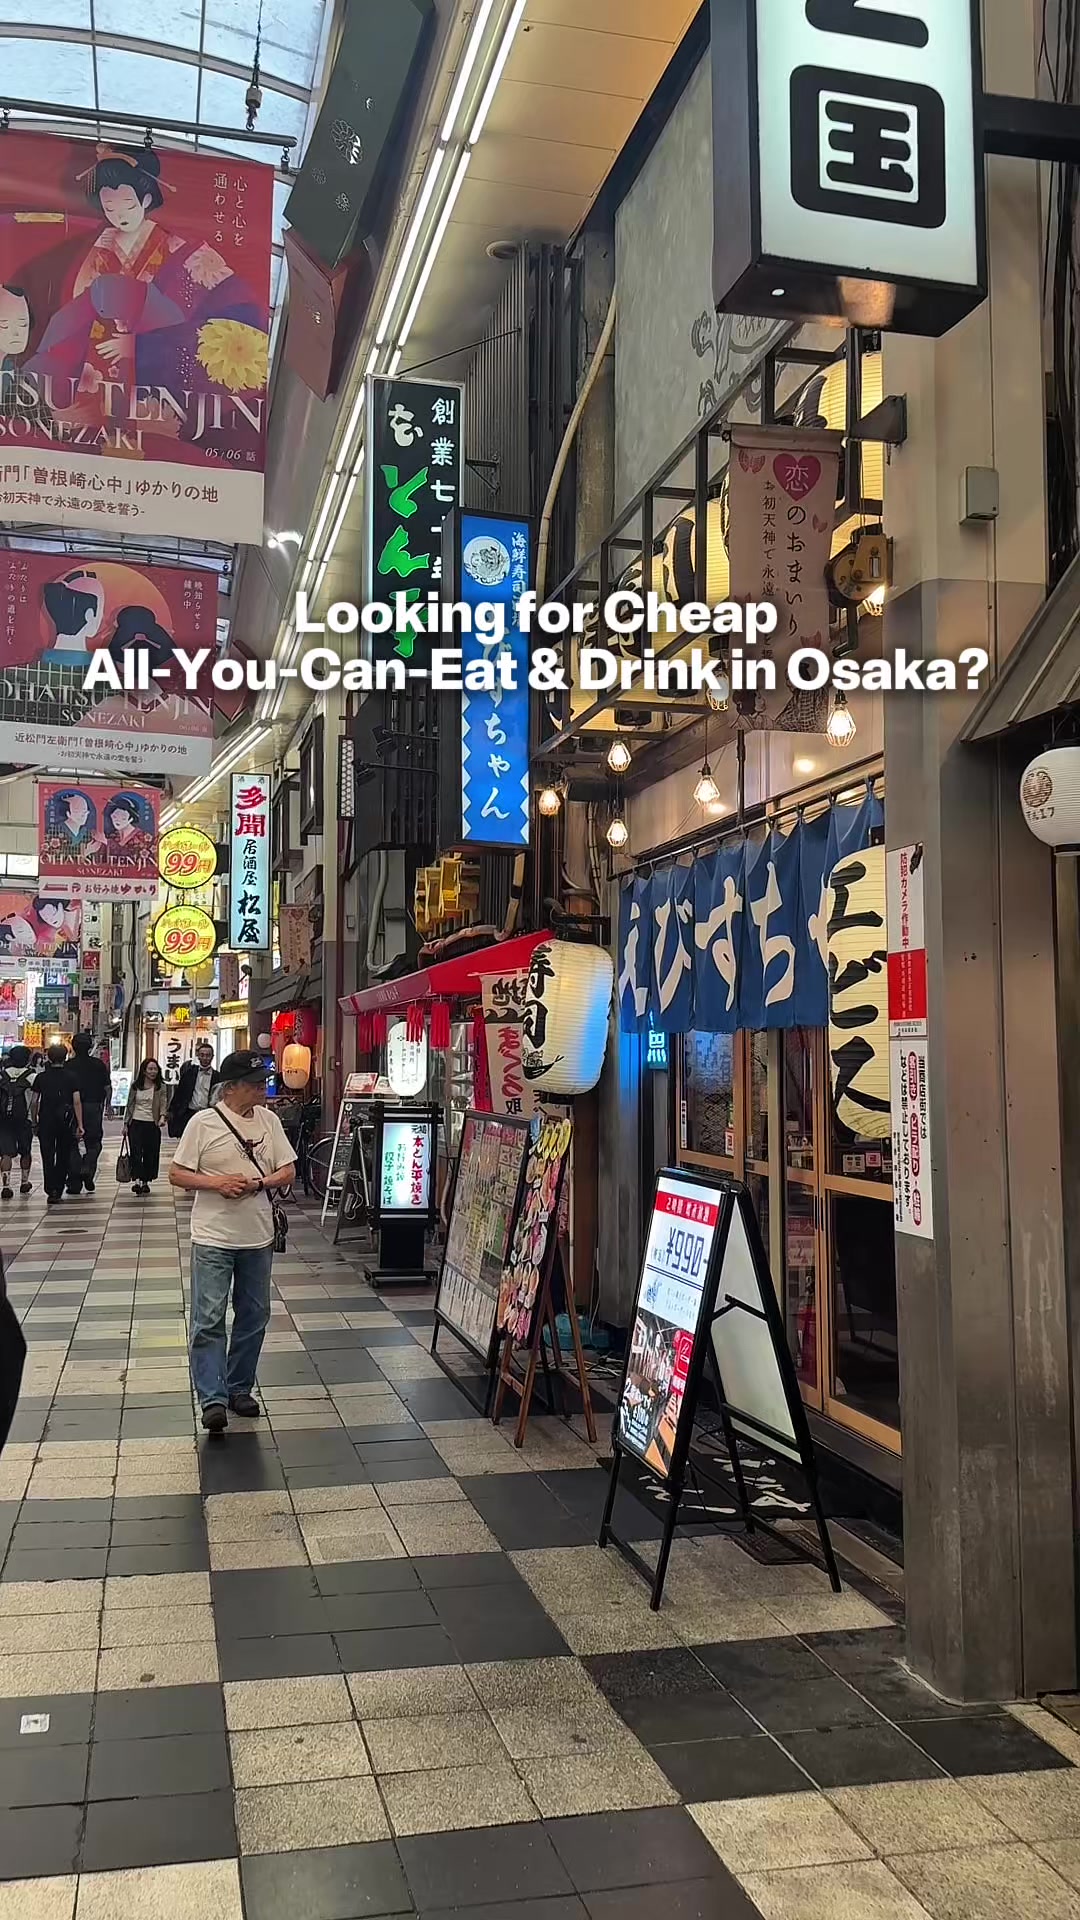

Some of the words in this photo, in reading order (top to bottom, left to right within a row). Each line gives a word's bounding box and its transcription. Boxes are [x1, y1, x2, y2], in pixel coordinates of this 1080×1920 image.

[212, 172, 229, 243] 通わせる
[232, 175, 248, 246] 心と心を
[97, 379, 265, 442] TENJIN
[0, 464, 219, 503] 門「曽根崎心中」ゆかりの地
[784, 464, 809, 638] 恋のおまいり
[61, 708, 147, 729] SONEZAKI
[234, 785, 268, 838] 多聞
[39, 854, 104, 867] OHATSU
[107, 854, 159, 872] TENJIN
[241, 838, 258, 886] 居酒屋
[237, 889, 262, 945] 松屋
[522, 943, 556, 1050] 寿司
[164, 1037, 183, 1083] うまい
[410, 1134, 425, 1206] 本とん平焼き
